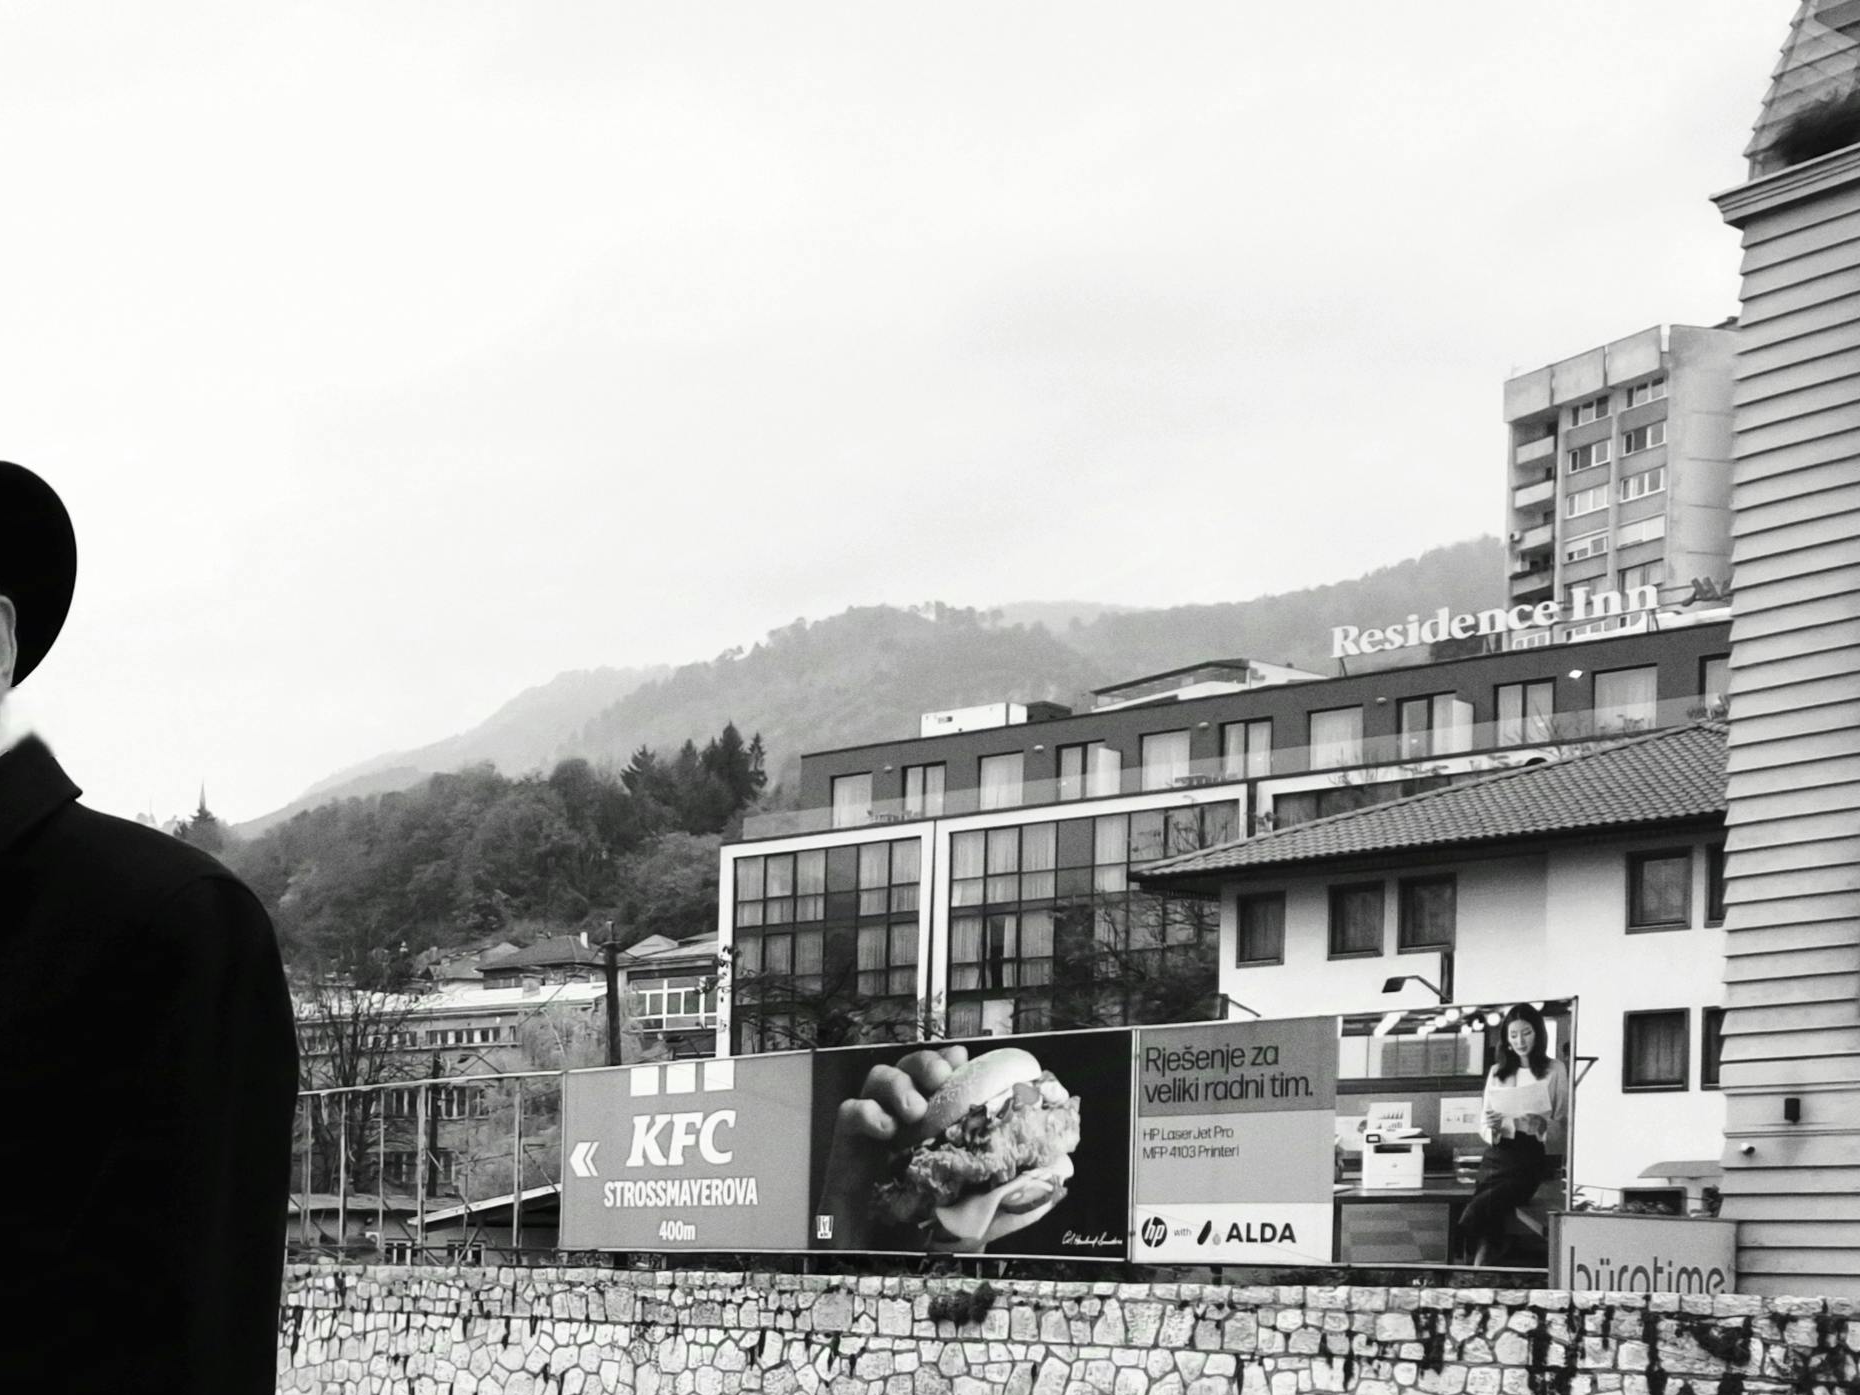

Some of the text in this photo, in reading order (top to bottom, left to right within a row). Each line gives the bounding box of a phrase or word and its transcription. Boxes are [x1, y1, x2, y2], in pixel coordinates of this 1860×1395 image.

[1330, 600, 1560, 659] Residence
[1571, 584, 1659, 622] Inn
[1145, 1043, 1279, 1077] Rješenje za
[1144, 1071, 1313, 1104] veliki radni tim.
[626, 1110, 736, 1167] KFC
[1143, 1128, 1160, 1140] HP
[1213, 1125, 1234, 1138] Pro
[1143, 1144, 1240, 1159] MFP 4103 Printeri
[604, 1177, 758, 1207] STROSSMAYEROVA
[659, 1220, 696, 1240] 400m
[1142, 1216, 1168, 1248] hp
[1174, 1228, 1192, 1237] with
[1225, 1222, 1297, 1243] ALDA
[1570, 1245, 1727, 1294] bürotime
